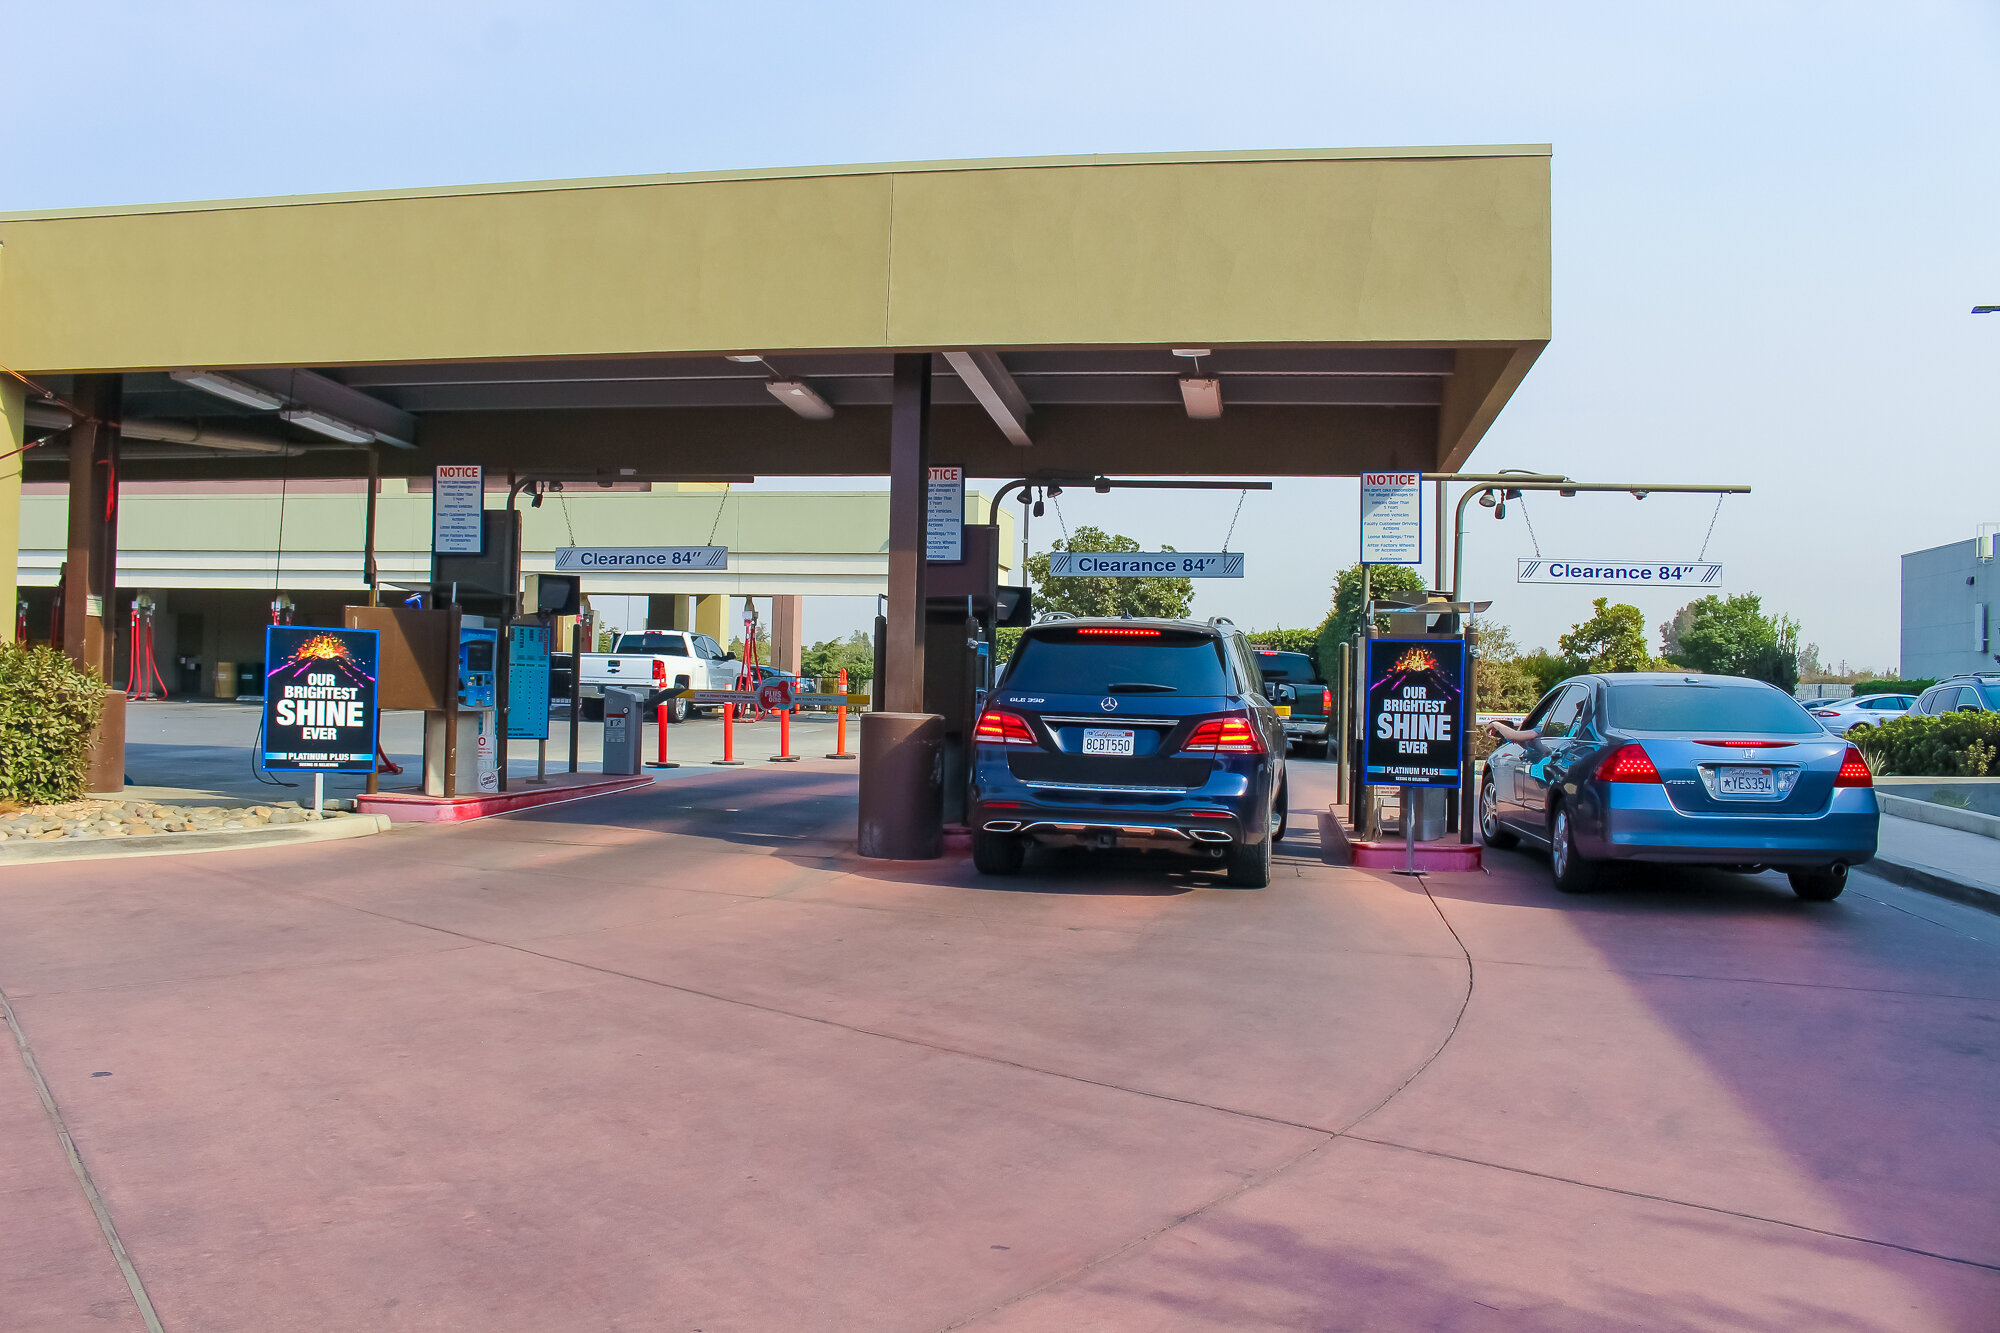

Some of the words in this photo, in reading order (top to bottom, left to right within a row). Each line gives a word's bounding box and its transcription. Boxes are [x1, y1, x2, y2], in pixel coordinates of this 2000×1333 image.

[440, 467, 478, 478] NOTICE
[928, 469, 957, 480] TICE
[1367, 475, 1415, 485] NOTICE
[580, 552, 667, 565] Clearance
[1078, 557, 1177, 572] Clearance
[1549, 563, 1652, 579] Clearance
[307, 673, 336, 687] OUR
[284, 686, 358, 700] BRIGHTEST
[1403, 686, 1427, 699] OUR
[1383, 699, 1446, 713] BRIGHTEST
[276, 699, 364, 727] SHINE
[302, 727, 337, 740] EVER
[1377, 713, 1451, 741] SHINE
[1086, 738, 1130, 752] 8CBT550
[1398, 741, 1428, 754] EVER
[288, 752, 328, 761] PLATINUM
[329, 753, 350, 761] PLUS
[1386, 766, 1420, 775] PLATINUM
[1732, 777, 1771, 790] YES354
